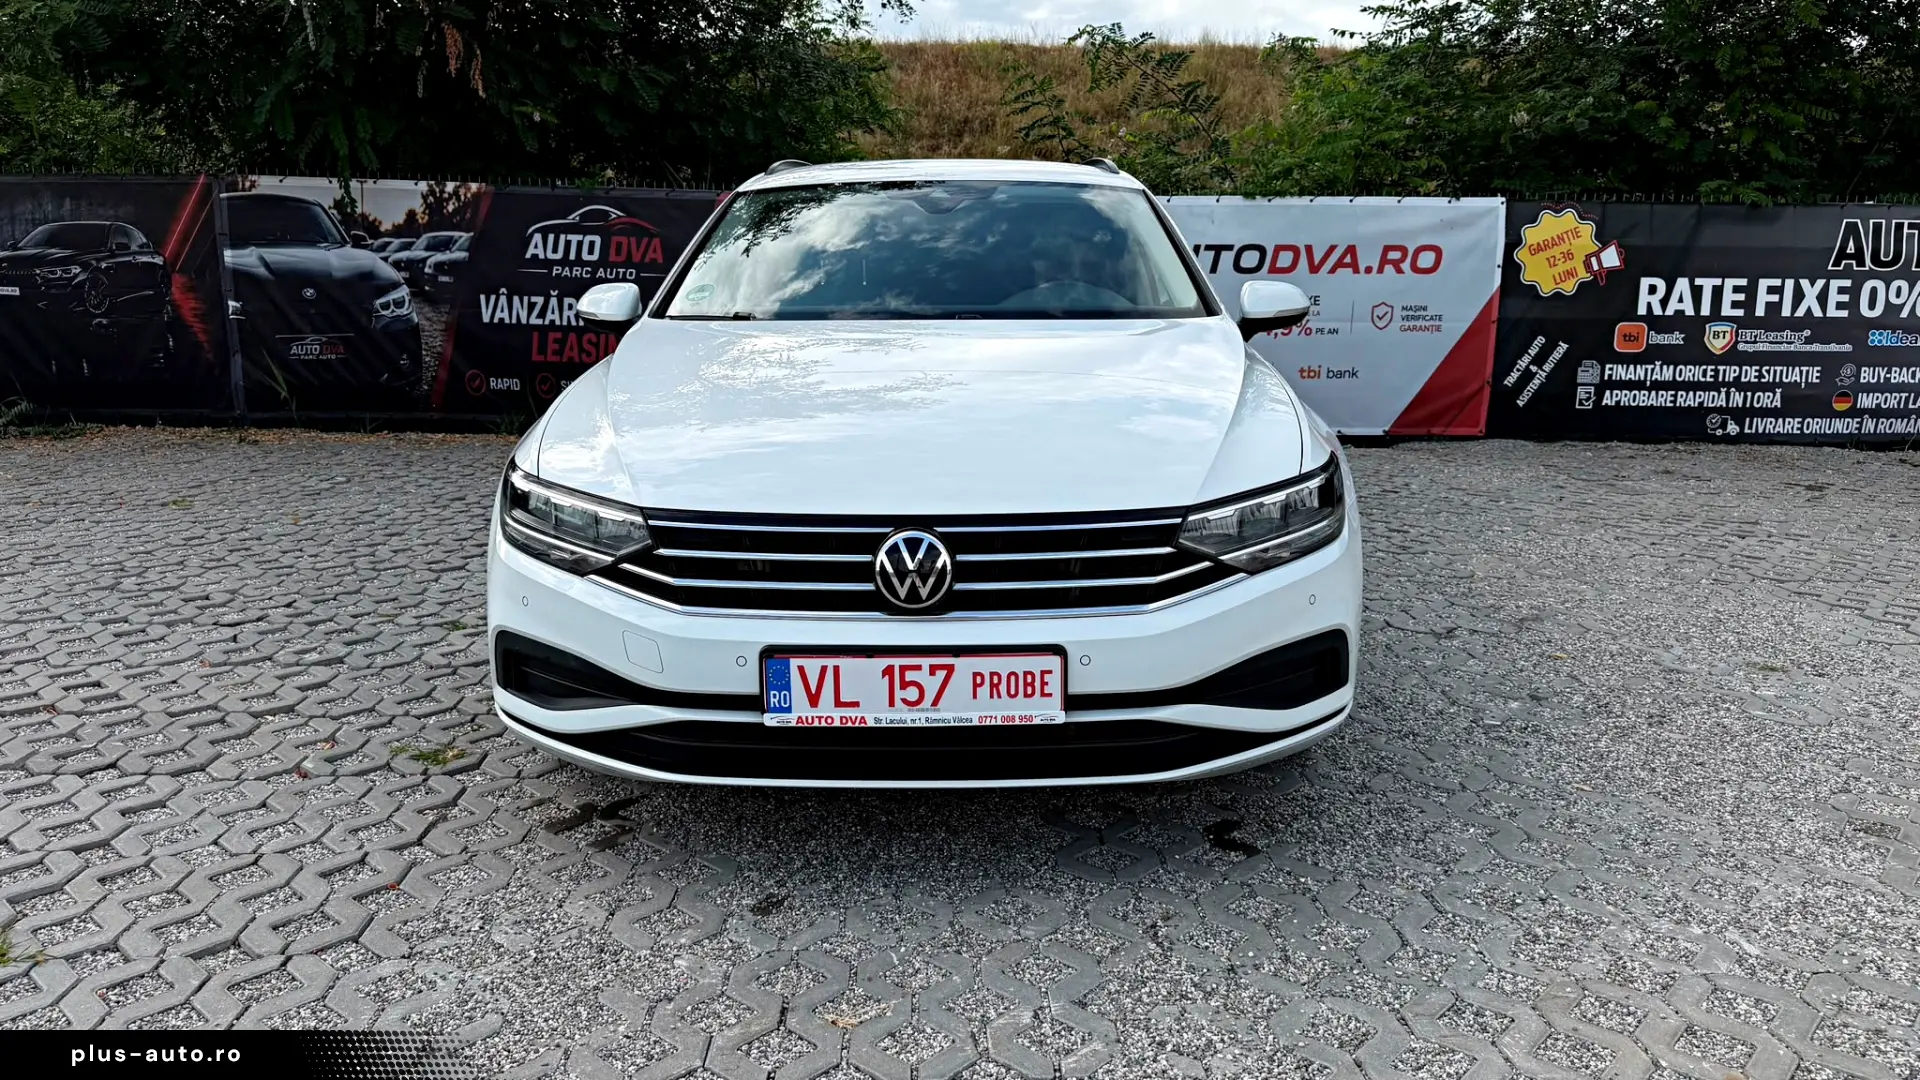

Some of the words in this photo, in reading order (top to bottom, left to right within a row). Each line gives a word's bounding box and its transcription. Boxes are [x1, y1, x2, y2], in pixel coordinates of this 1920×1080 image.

[525, 233, 601, 261] AUTO
[608, 236, 663, 264] DVA
[1528, 226, 1582, 256] GARANȚIE
[1545, 248, 1575, 269] 12-36
[552, 266, 592, 278] PARC
[596, 268, 636, 280] AUTO
[1552, 266, 1579, 286] LUNI
[1637, 277, 1748, 317] RATE
[1755, 278, 1852, 318] FIXE
[480, 288, 585, 327] VÂNZĂR
[1401, 314, 1444, 322] VERIFICATE
[1315, 327, 1326, 336] PE
[1327, 327, 1339, 336] AN
[1623, 332, 1640, 343] tbi
[1648, 331, 1686, 345] bank
[1712, 330, 1729, 340] BT
[1738, 329, 1757, 341] BT
[290, 345, 320, 355] AUTO
[1527, 335, 1546, 357] AUTO
[1298, 365, 1322, 379] tbi
[1326, 366, 1359, 379] bank
[1604, 361, 1674, 386] FINANȚĂM
[1675, 364, 1715, 382] ORICE
[1717, 365, 1740, 382] TIP
[1740, 366, 1759, 383] DE
[1760, 366, 1821, 388] SITUAȚIE
[490, 377, 520, 391] RAPID
[1601, 389, 1675, 406] APROBARE
[1676, 387, 1727, 408] RAPIDĂ
[1728, 387, 1744, 408] ÎN
[1753, 388, 1783, 409] ORĂ
[1856, 392, 1908, 409] IMPORT
[1744, 417, 1801, 434] LIVRARE
[1803, 418, 1861, 434] ORIUNDE
[1862, 414, 1876, 434] ÎN
[770, 690, 790, 708] RO
[797, 664, 860, 708] VL
[881, 664, 955, 708] 157
[972, 669, 1053, 700] PROBE
[795, 715, 835, 726] AUTO
[839, 716, 868, 726] DVA
[873, 716, 884, 725] Str.
[978, 715, 998, 724] 0771
[1000, 715, 1016, 723] 008
[1018, 714, 1034, 723] 950
